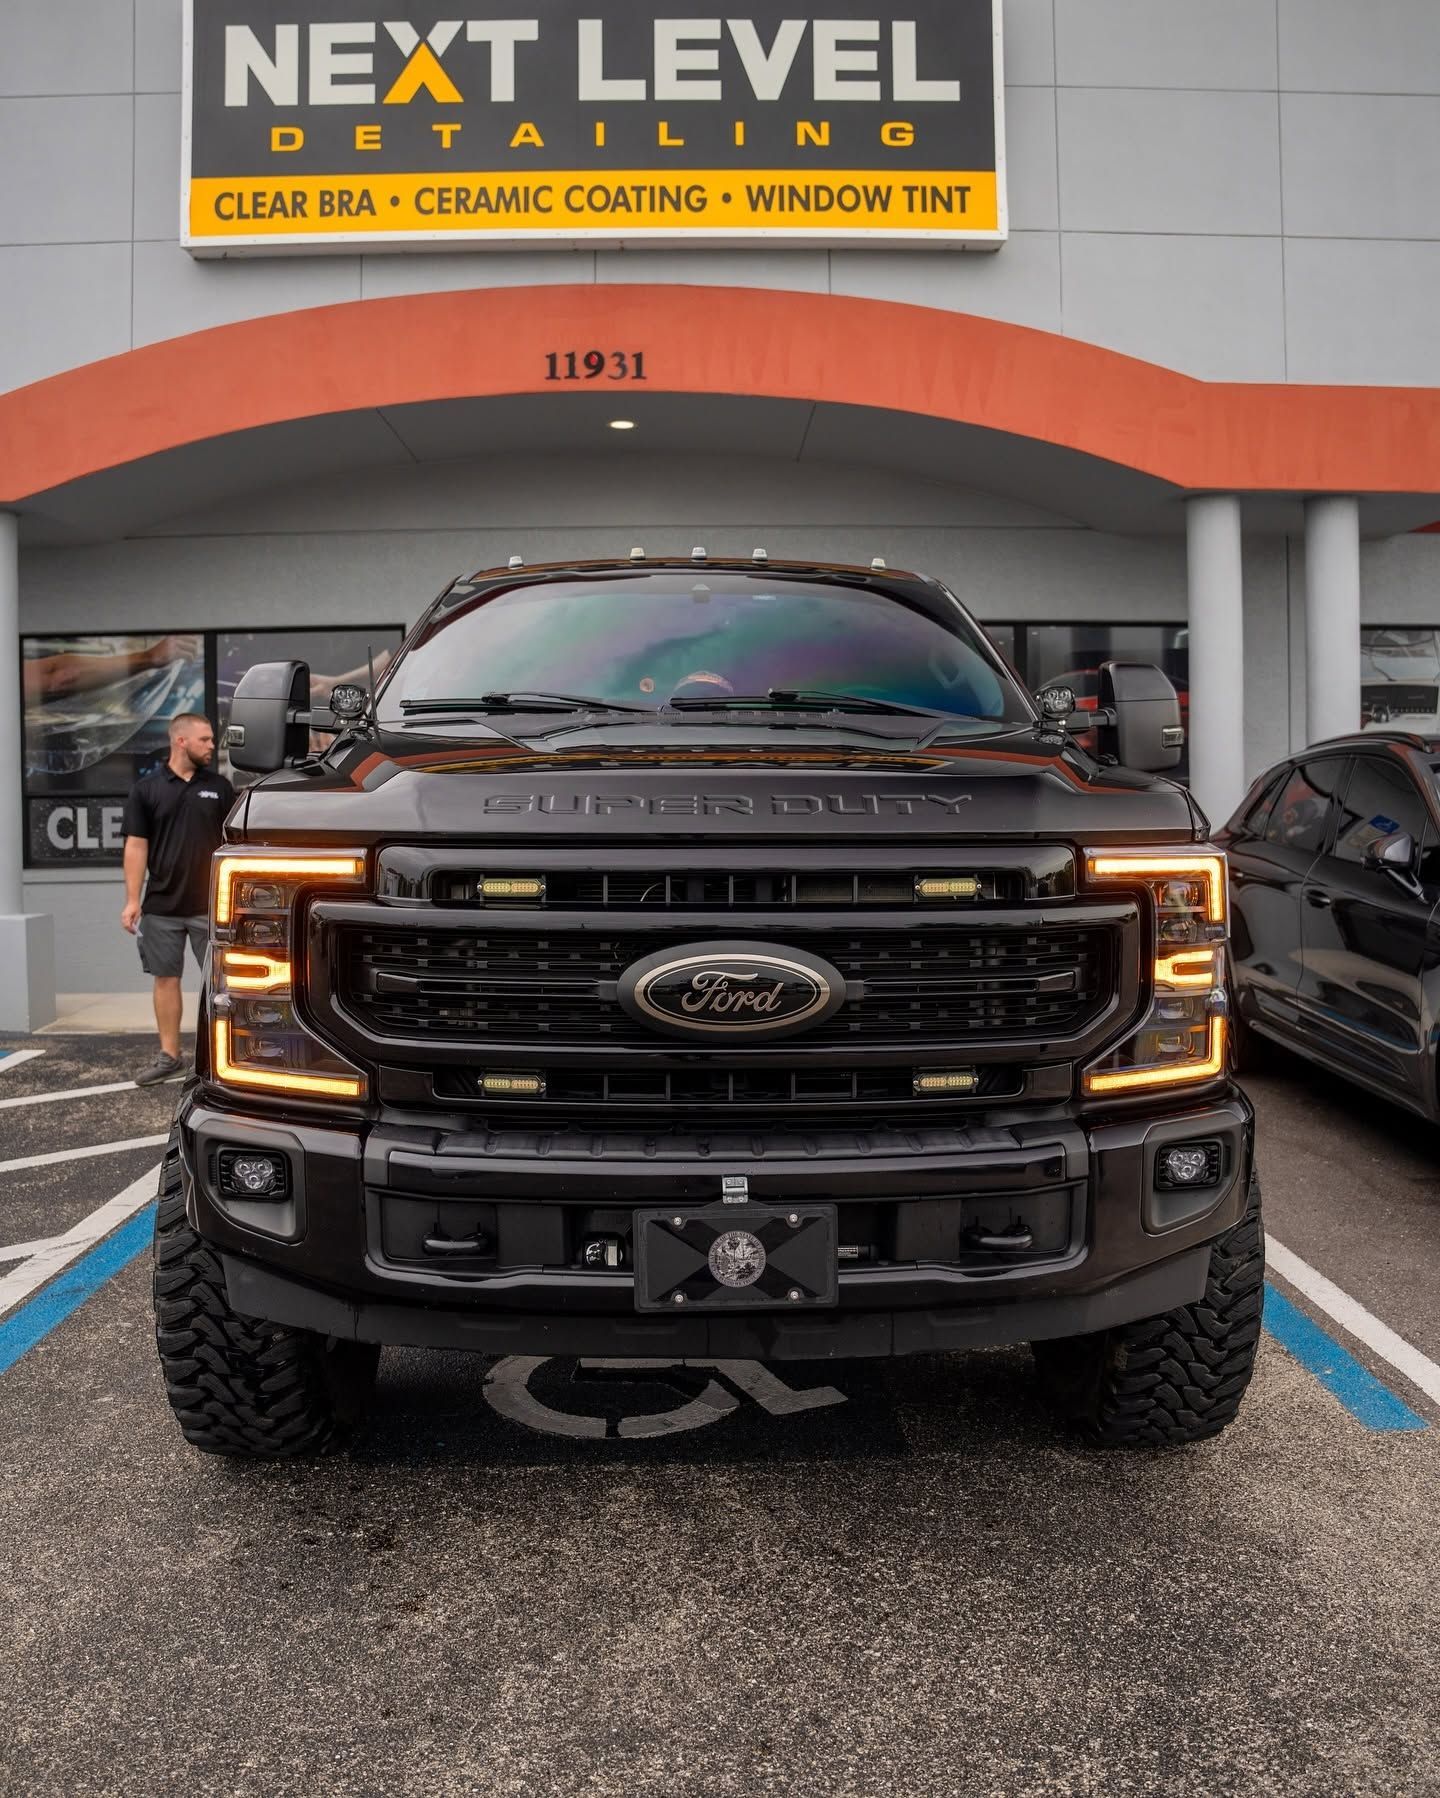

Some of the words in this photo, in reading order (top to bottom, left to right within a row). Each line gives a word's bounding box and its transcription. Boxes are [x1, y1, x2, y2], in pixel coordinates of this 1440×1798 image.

[223, 19, 538, 107] NEXT
[577, 18, 961, 101] LEVEL
[270, 121, 915, 152] DETAILING
[214, 191, 308, 220] CLEAR
[319, 190, 377, 217] BRA
[414, 186, 553, 214] CERAMIC
[564, 185, 708, 213] COATING
[745, 185, 893, 213] WINDOW
[902, 185, 971, 214] TINT
[544, 350, 647, 380] 11931
[483, 794, 754, 815] SUPER
[770, 794, 972, 815] DUTY
[680, 970, 785, 1013] Ford
